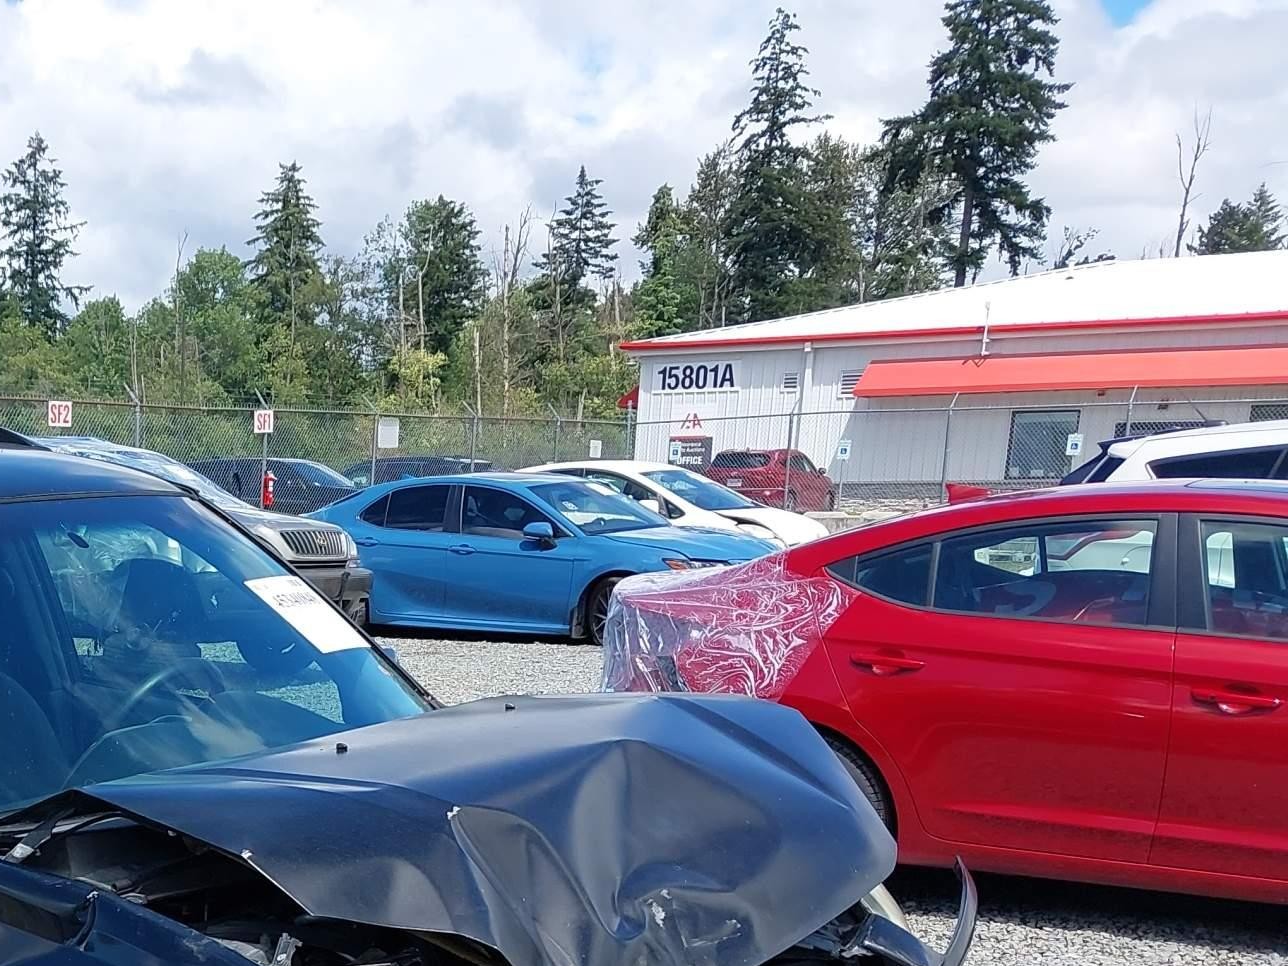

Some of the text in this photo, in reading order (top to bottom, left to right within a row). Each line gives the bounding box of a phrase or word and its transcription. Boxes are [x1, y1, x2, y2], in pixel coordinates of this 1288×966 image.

[657, 363, 735, 391] 15801A
[50, 403, 70, 424] SF2
[257, 412, 271, 431] SF1
[676, 455, 703, 465] OFFICE
